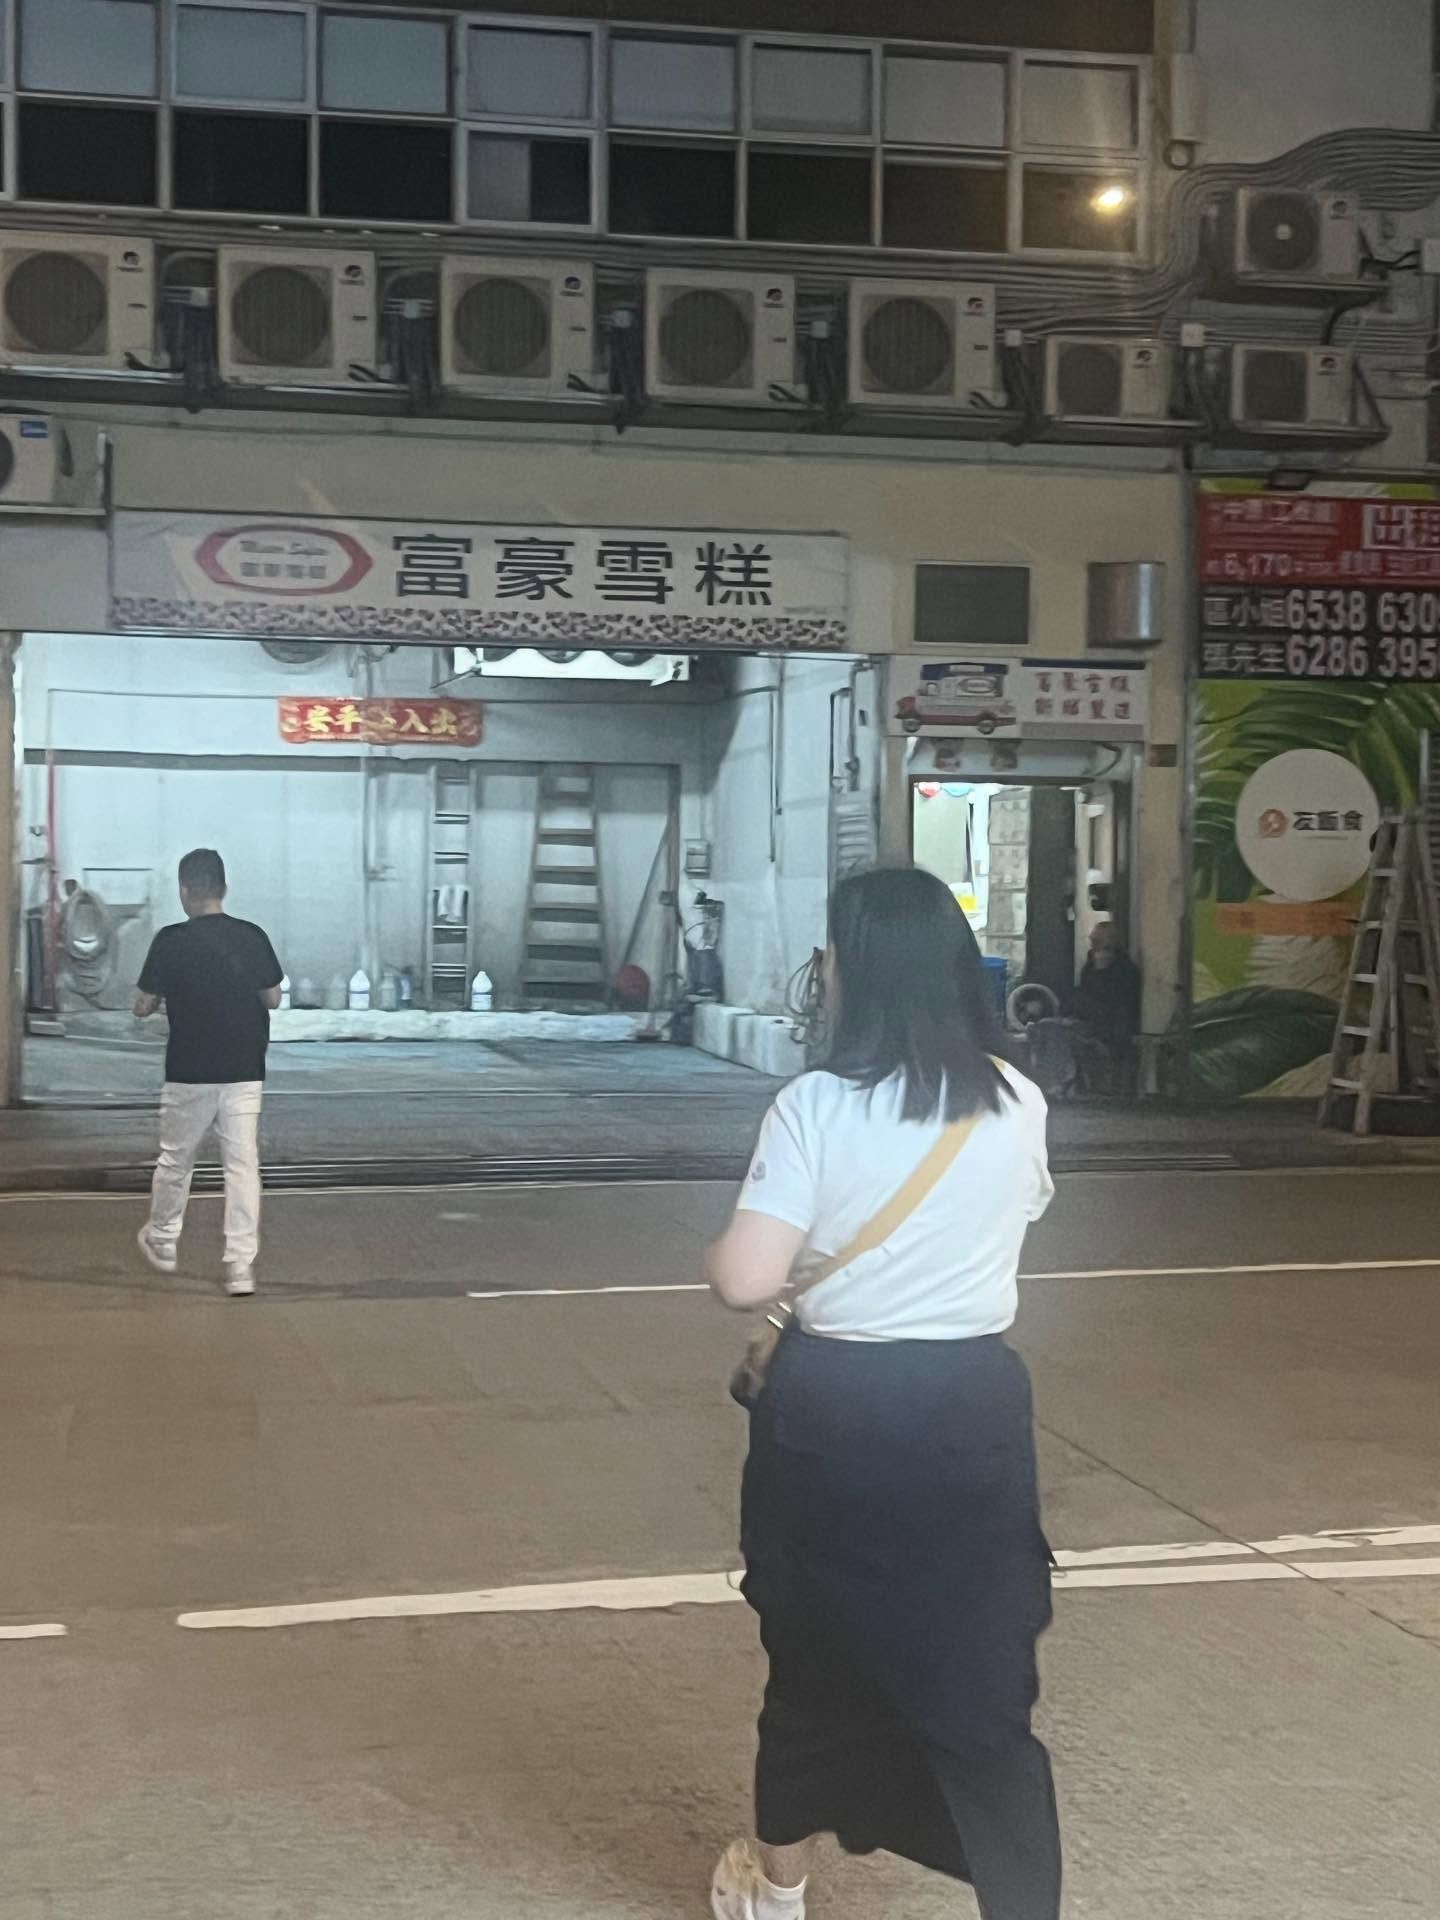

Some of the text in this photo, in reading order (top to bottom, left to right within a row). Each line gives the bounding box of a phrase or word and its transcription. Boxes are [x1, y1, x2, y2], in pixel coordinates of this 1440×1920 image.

[391, 533, 773, 607] 富豪雪糕
[1287, 588, 1367, 632] 6538
[1377, 591, 1440, 633] 630
[1287, 634, 1369, 677] 6286
[1377, 637, 1440, 679] 395
